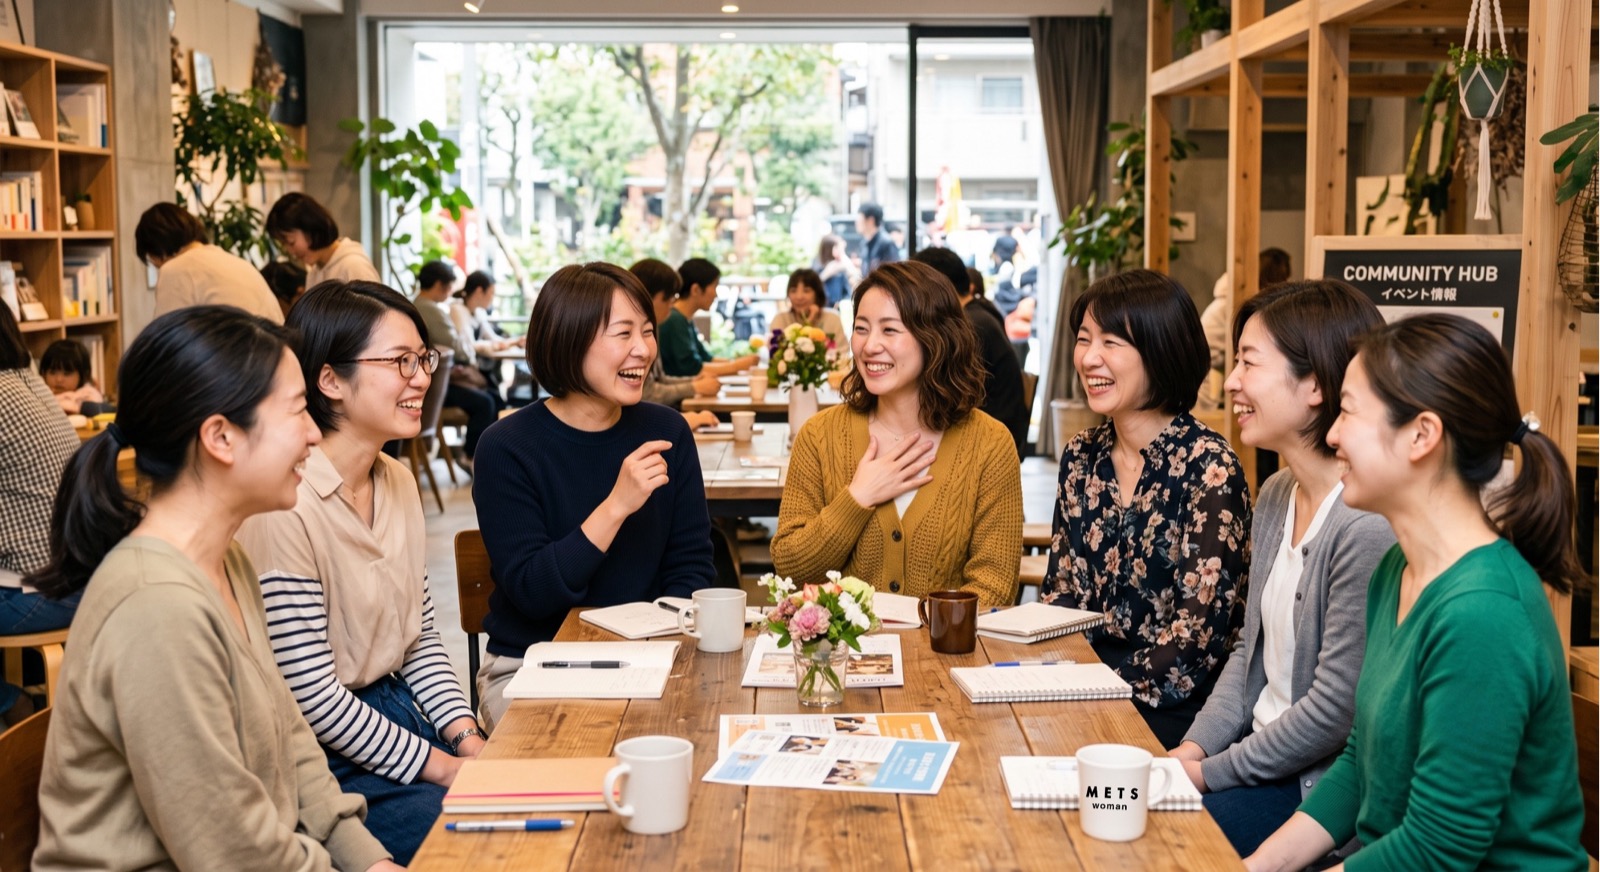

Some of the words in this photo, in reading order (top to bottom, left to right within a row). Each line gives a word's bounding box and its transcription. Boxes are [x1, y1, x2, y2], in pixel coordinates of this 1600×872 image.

[1343, 265, 1454, 281] COMMUNITY
[1458, 265, 1498, 282] HUB
[1381, 287, 1457, 301] イベント情報
[1085, 785, 1139, 800] METS
[1092, 802, 1128, 811] woman
